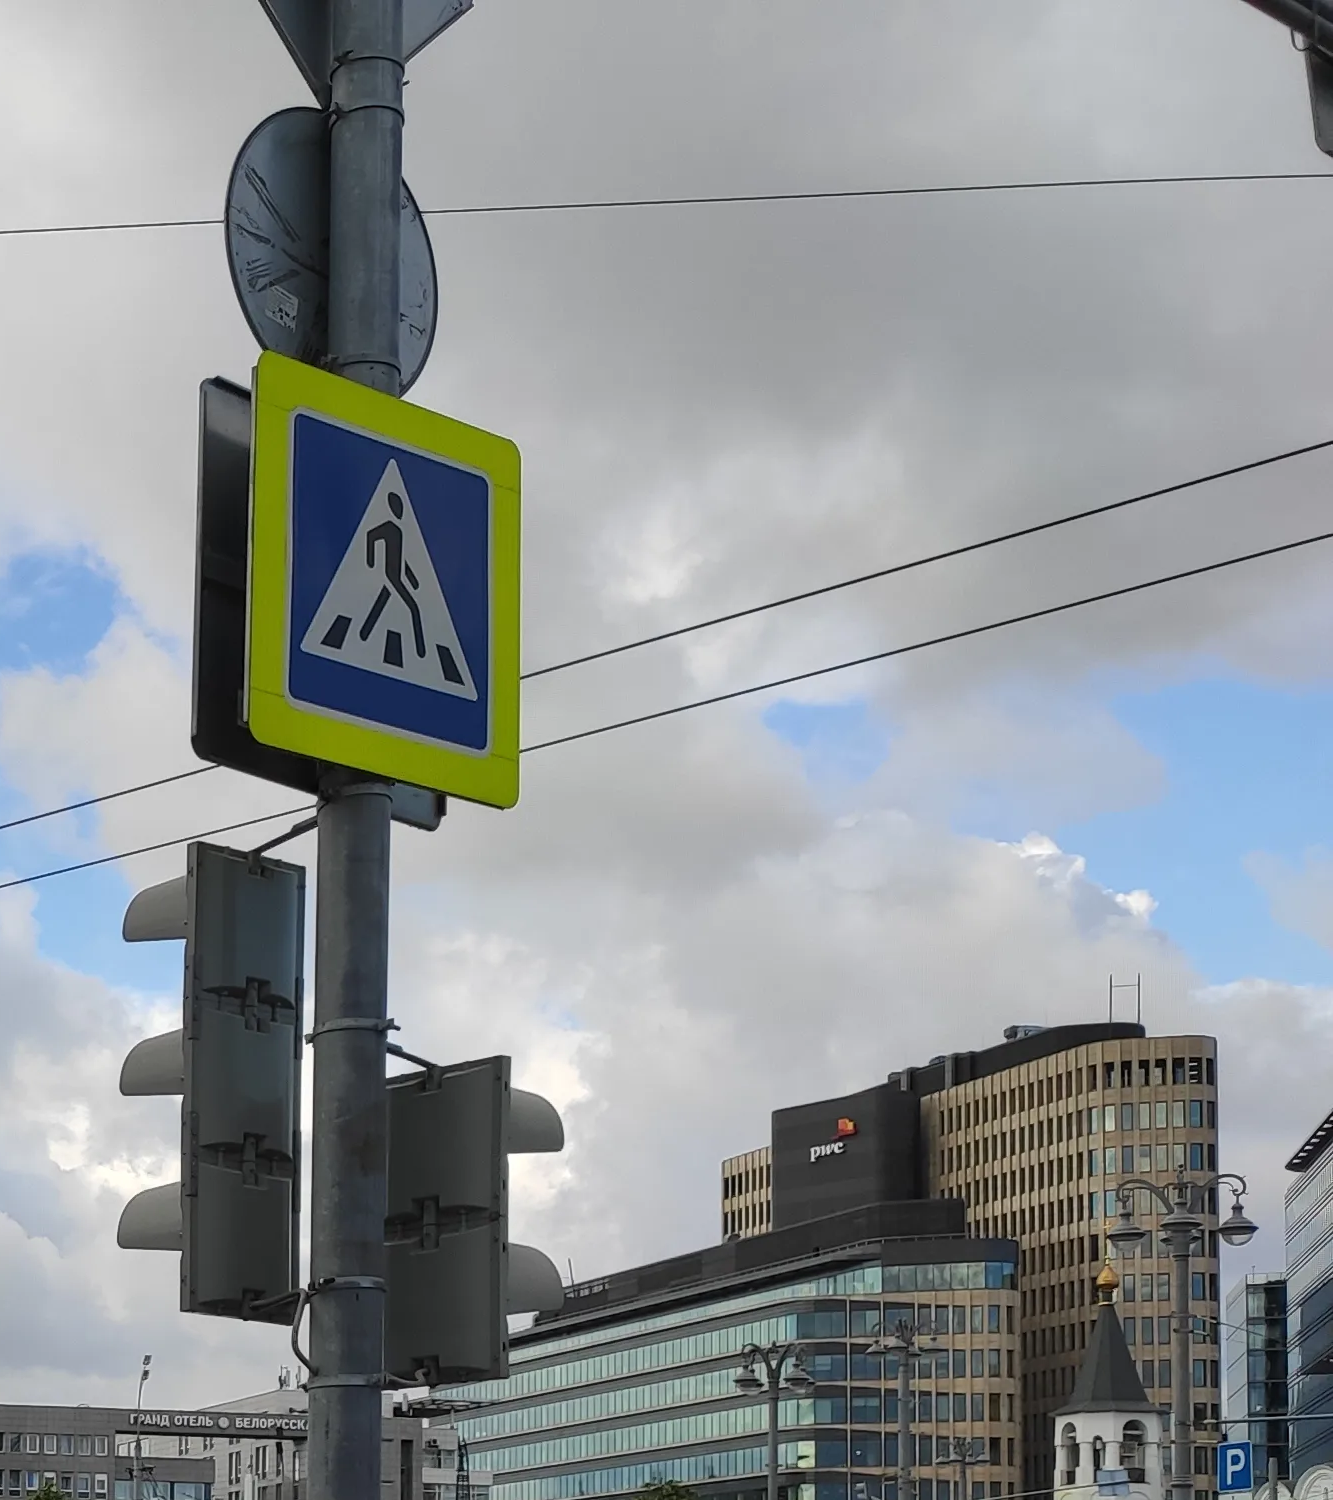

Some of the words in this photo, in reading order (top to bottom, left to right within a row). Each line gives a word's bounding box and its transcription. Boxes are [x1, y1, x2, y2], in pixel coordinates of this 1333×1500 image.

[810, 1141, 844, 1162] pwc
[130, 1413, 170, 1428] ГРАНД
[174, 1415, 213, 1427] ОТЕЛЬ
[1226, 1448, 1245, 1486] P
